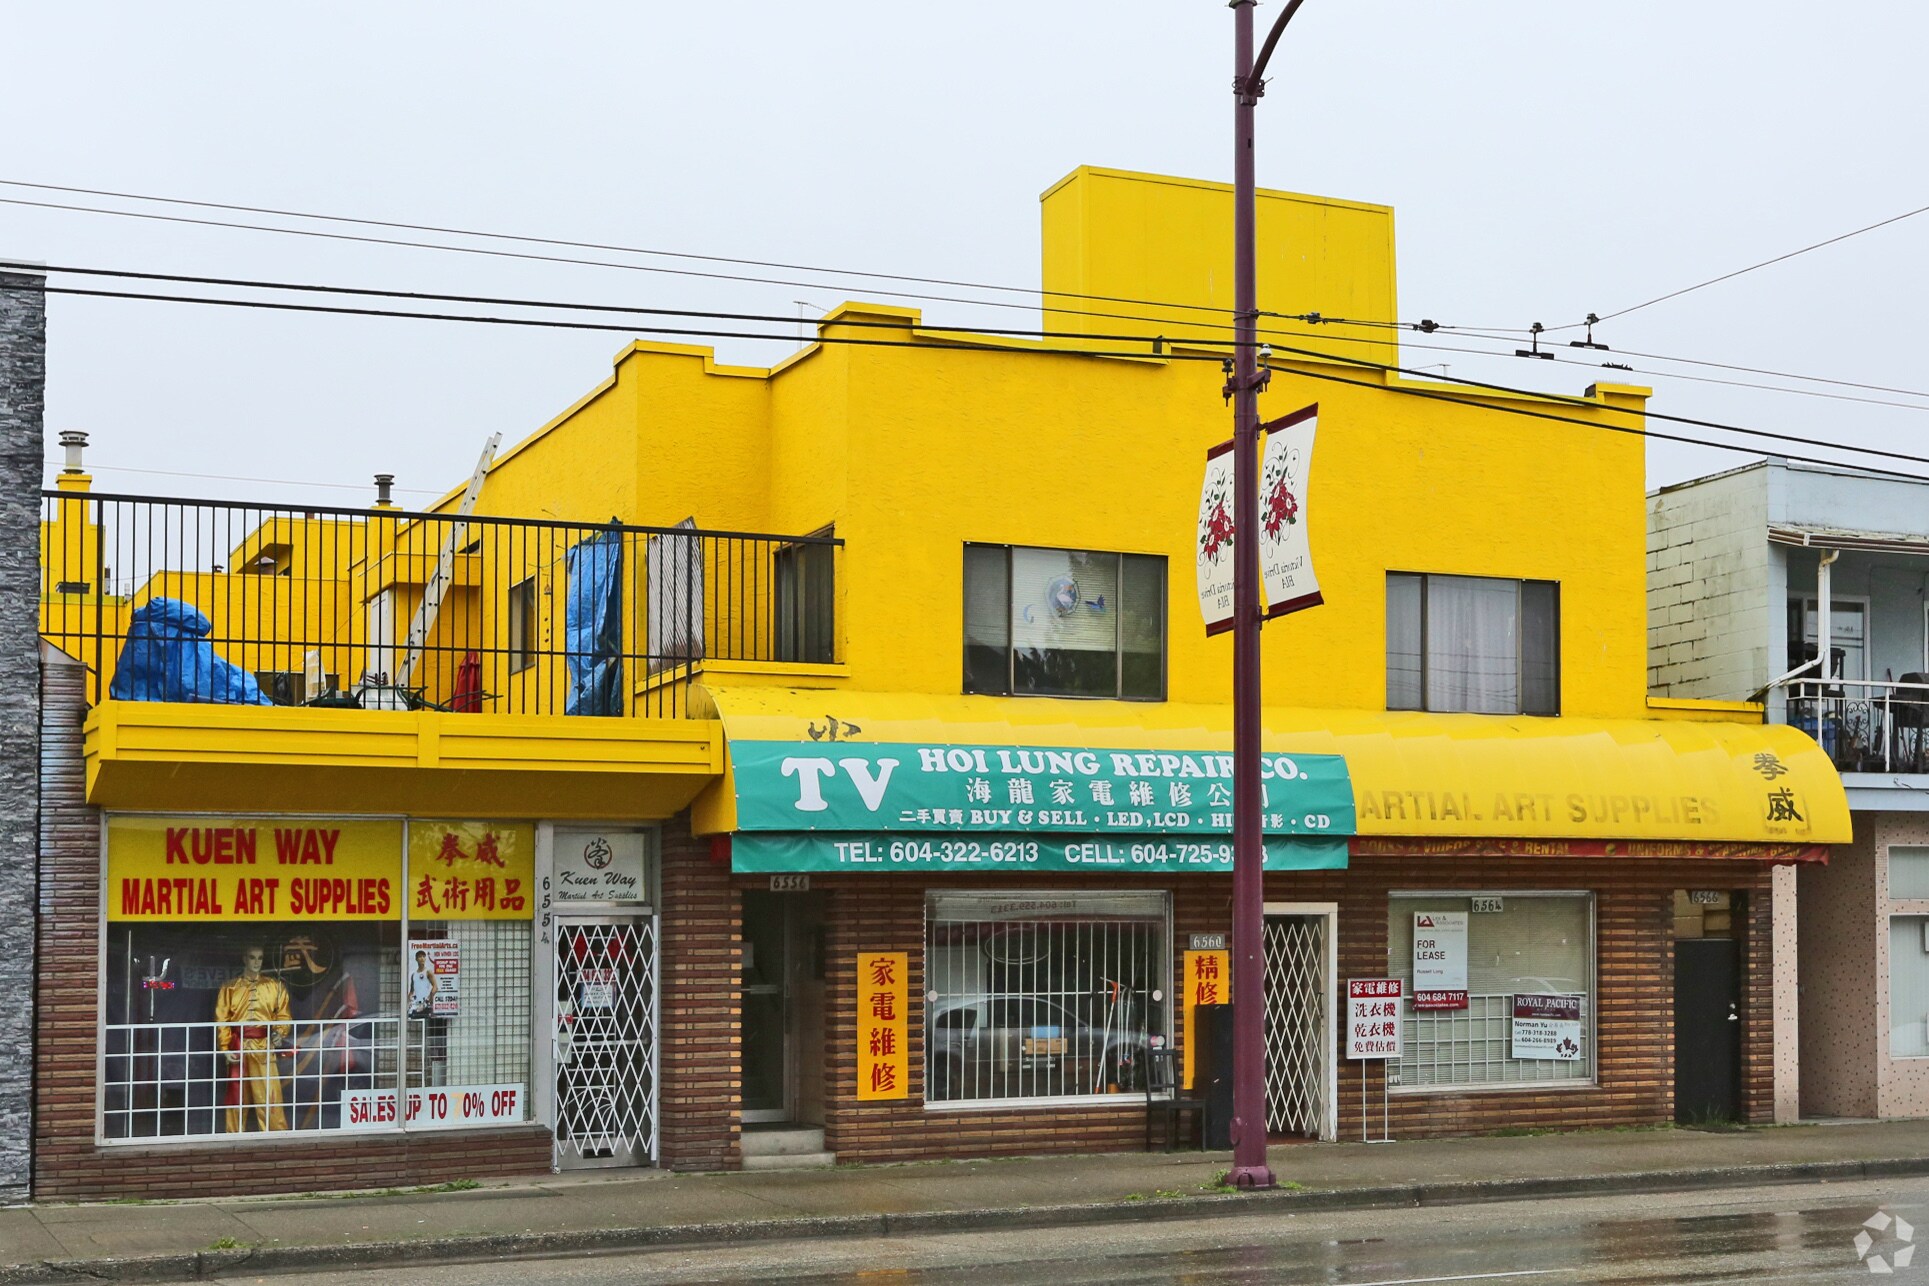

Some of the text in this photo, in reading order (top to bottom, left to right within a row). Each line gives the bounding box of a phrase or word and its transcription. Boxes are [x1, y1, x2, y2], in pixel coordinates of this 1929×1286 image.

[917, 748, 1308, 780] HOI LUNG REPAIR CO.
[781, 757, 900, 812] TV
[1492, 792, 1554, 822] ART
[1566, 793, 1721, 825] SUPPLIES
[899, 809, 964, 825] 二手買賣
[970, 810, 1012, 825] BUY
[1017, 810, 1034, 825] &
[1038, 811, 1088, 826] SELL
[1304, 815, 1330, 829] CD
[166, 828, 341, 864] KUEN WAY
[436, 833, 505, 868] 拳威
[834, 843, 882, 863] TEL:
[889, 842, 1039, 863] 604-322-6213
[1064, 843, 1126, 863] CELL:
[560, 871, 637, 888] Kuen Way
[121, 877, 391, 915] MARTIAL ART SUPPLIES
[417, 873, 525, 914] 武術用品
[591, 890, 604, 900] Art
[1473, 899, 1502, 912] 6564
[1193, 935, 1222, 949] 6560
[1417, 940, 1436, 949] FOR
[1417, 951, 1446, 960] LEASE
[1352, 981, 1399, 995] 家電維修
[1417, 992, 1465, 1002] 604 684 7117
[1517, 997, 1577, 1009] ROYAL PACIFIC
[1355, 1002, 1396, 1017] 洗衣機
[869, 957, 896, 1093] 家電維修
[1354, 1022, 1396, 1037] 乾衣機
[350, 1095, 396, 1124] SALES
[429, 1092, 448, 1120] TO
[451, 1092, 485, 1120] 70%
[492, 1090, 517, 1118] OFF
